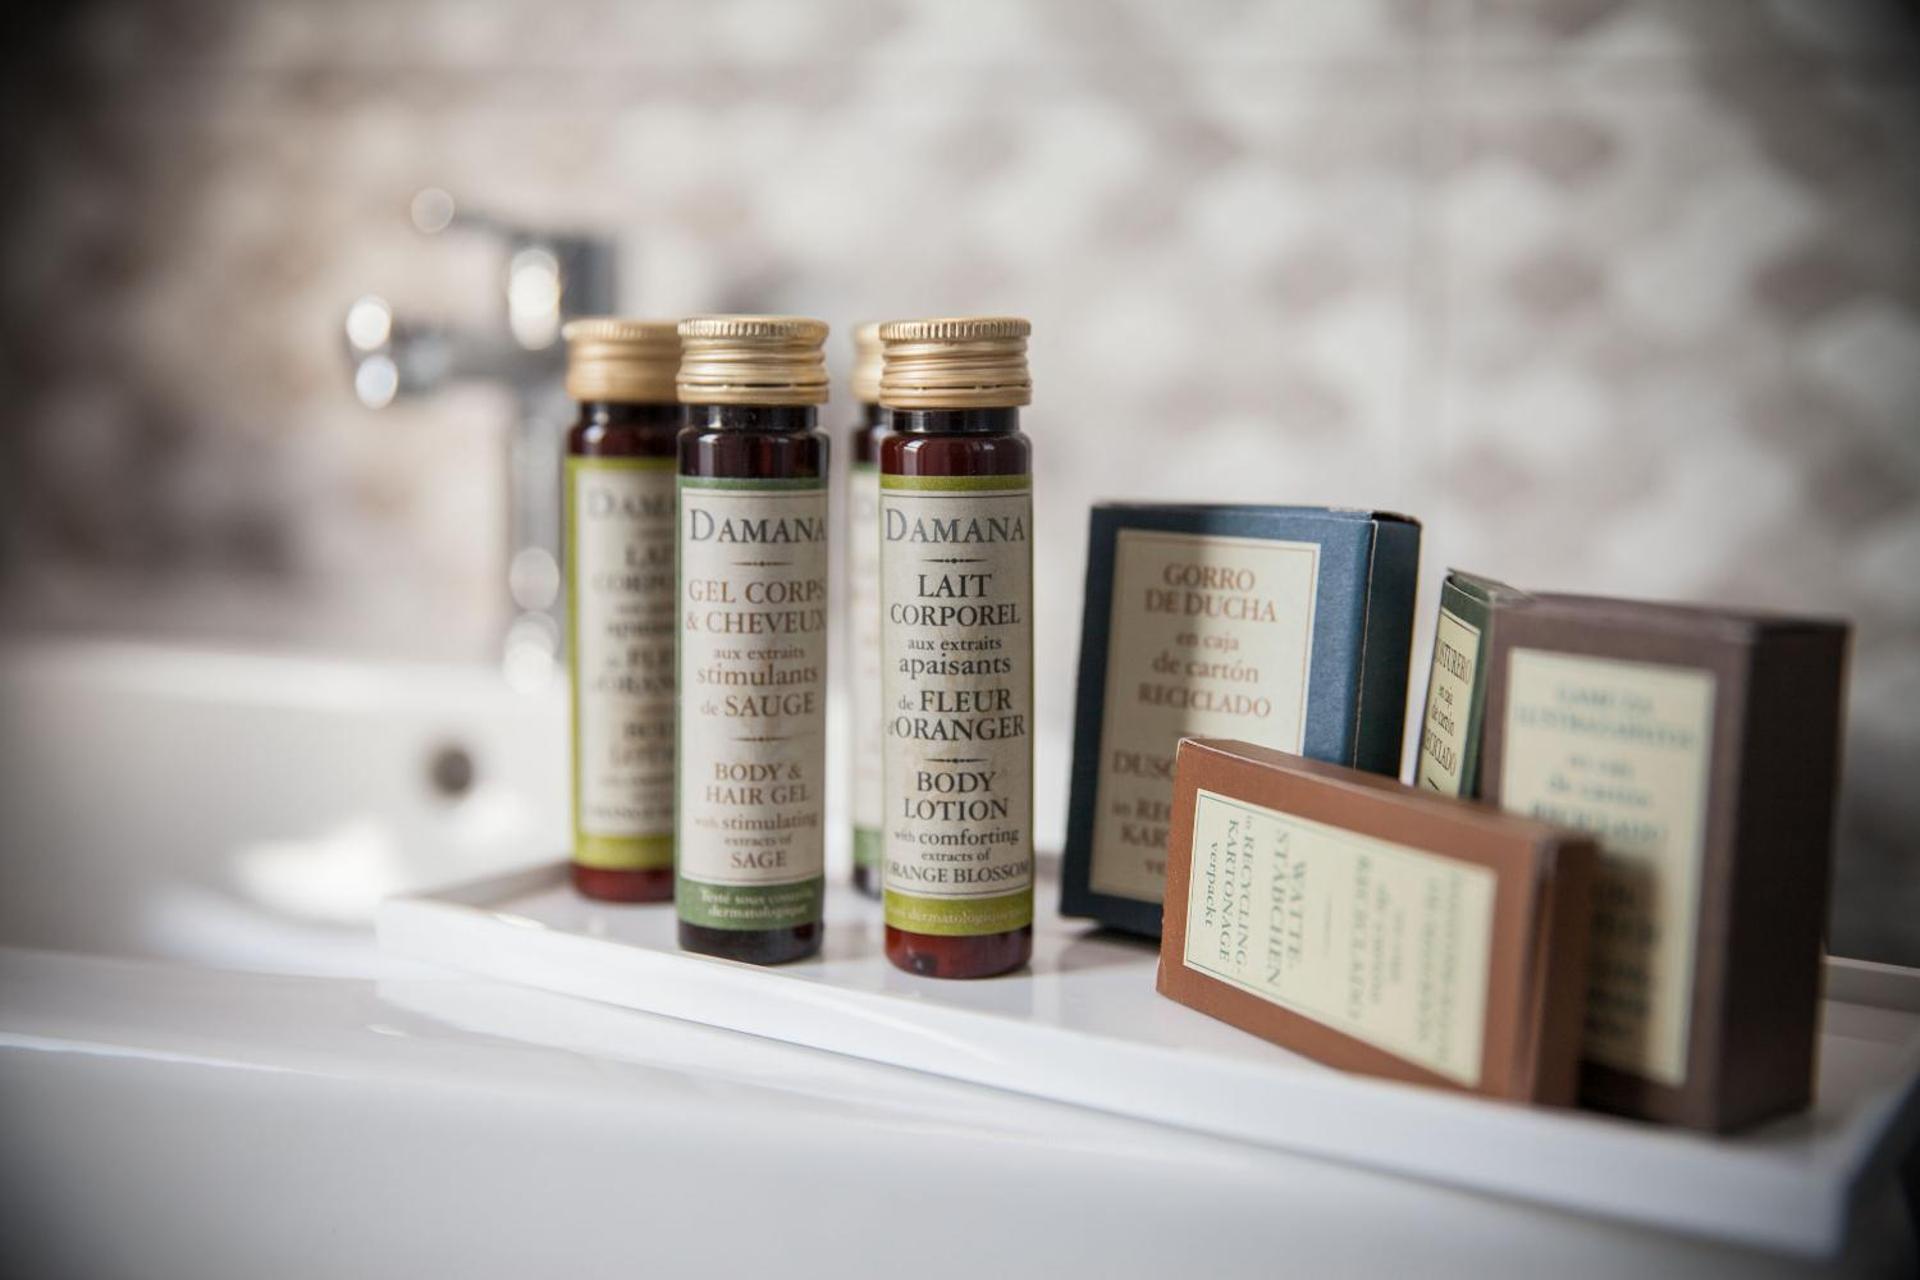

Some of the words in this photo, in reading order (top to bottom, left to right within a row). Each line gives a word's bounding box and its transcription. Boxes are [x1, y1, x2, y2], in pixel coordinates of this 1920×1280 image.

[690, 508, 826, 543] DAMANA
[886, 508, 1025, 543] DAMANA
[918, 573, 992, 598] LAIT
[1163, 563, 1255, 591] GORRO
[689, 579, 736, 604] GEL
[745, 579, 824, 604] CORPS
[890, 603, 1021, 627] CORPOREL
[1145, 588, 1177, 614] DE
[1184, 591, 1277, 622] DUCHA
[686, 614, 699, 632] &
[706, 609, 826, 634] CHEVEUX
[714, 648, 741, 660] aux
[747, 645, 805, 660] extraits
[908, 638, 935, 650] aux
[940, 636, 1002, 651] extraits
[1176, 632, 1198, 646] en
[1203, 630, 1240, 654] caja
[697, 664, 817, 686] stimulants
[899, 653, 1011, 680] apaisants
[1152, 653, 1180, 674] de
[1185, 660, 1259, 683] cartón
[701, 700, 719, 716] de
[725, 692, 815, 717] SAUGE
[898, 695, 914, 711] de
[920, 689, 1012, 713] FLEUR
[1138, 682, 1271, 718] RECICLADO
[715, 763, 783, 782] BODY
[787, 763, 801, 780] &
[917, 771, 996, 794] BODY
[706, 785, 764, 806] HAIR
[770, 783, 811, 804] GEL
[722, 811, 817, 831] stimulating
[903, 798, 1008, 821] LOTION
[724, 835, 776, 846] extracts
[894, 829, 915, 843] with
[919, 828, 1019, 847] comforting
[731, 850, 787, 869] SAGE
[921, 850, 973, 863] extracts
[976, 849, 990, 861] of
[1204, 841, 1219, 928] verpackt
[1219, 818, 1239, 963] KARTONAGE
[1234, 832, 1255, 975] RECYCLING-
